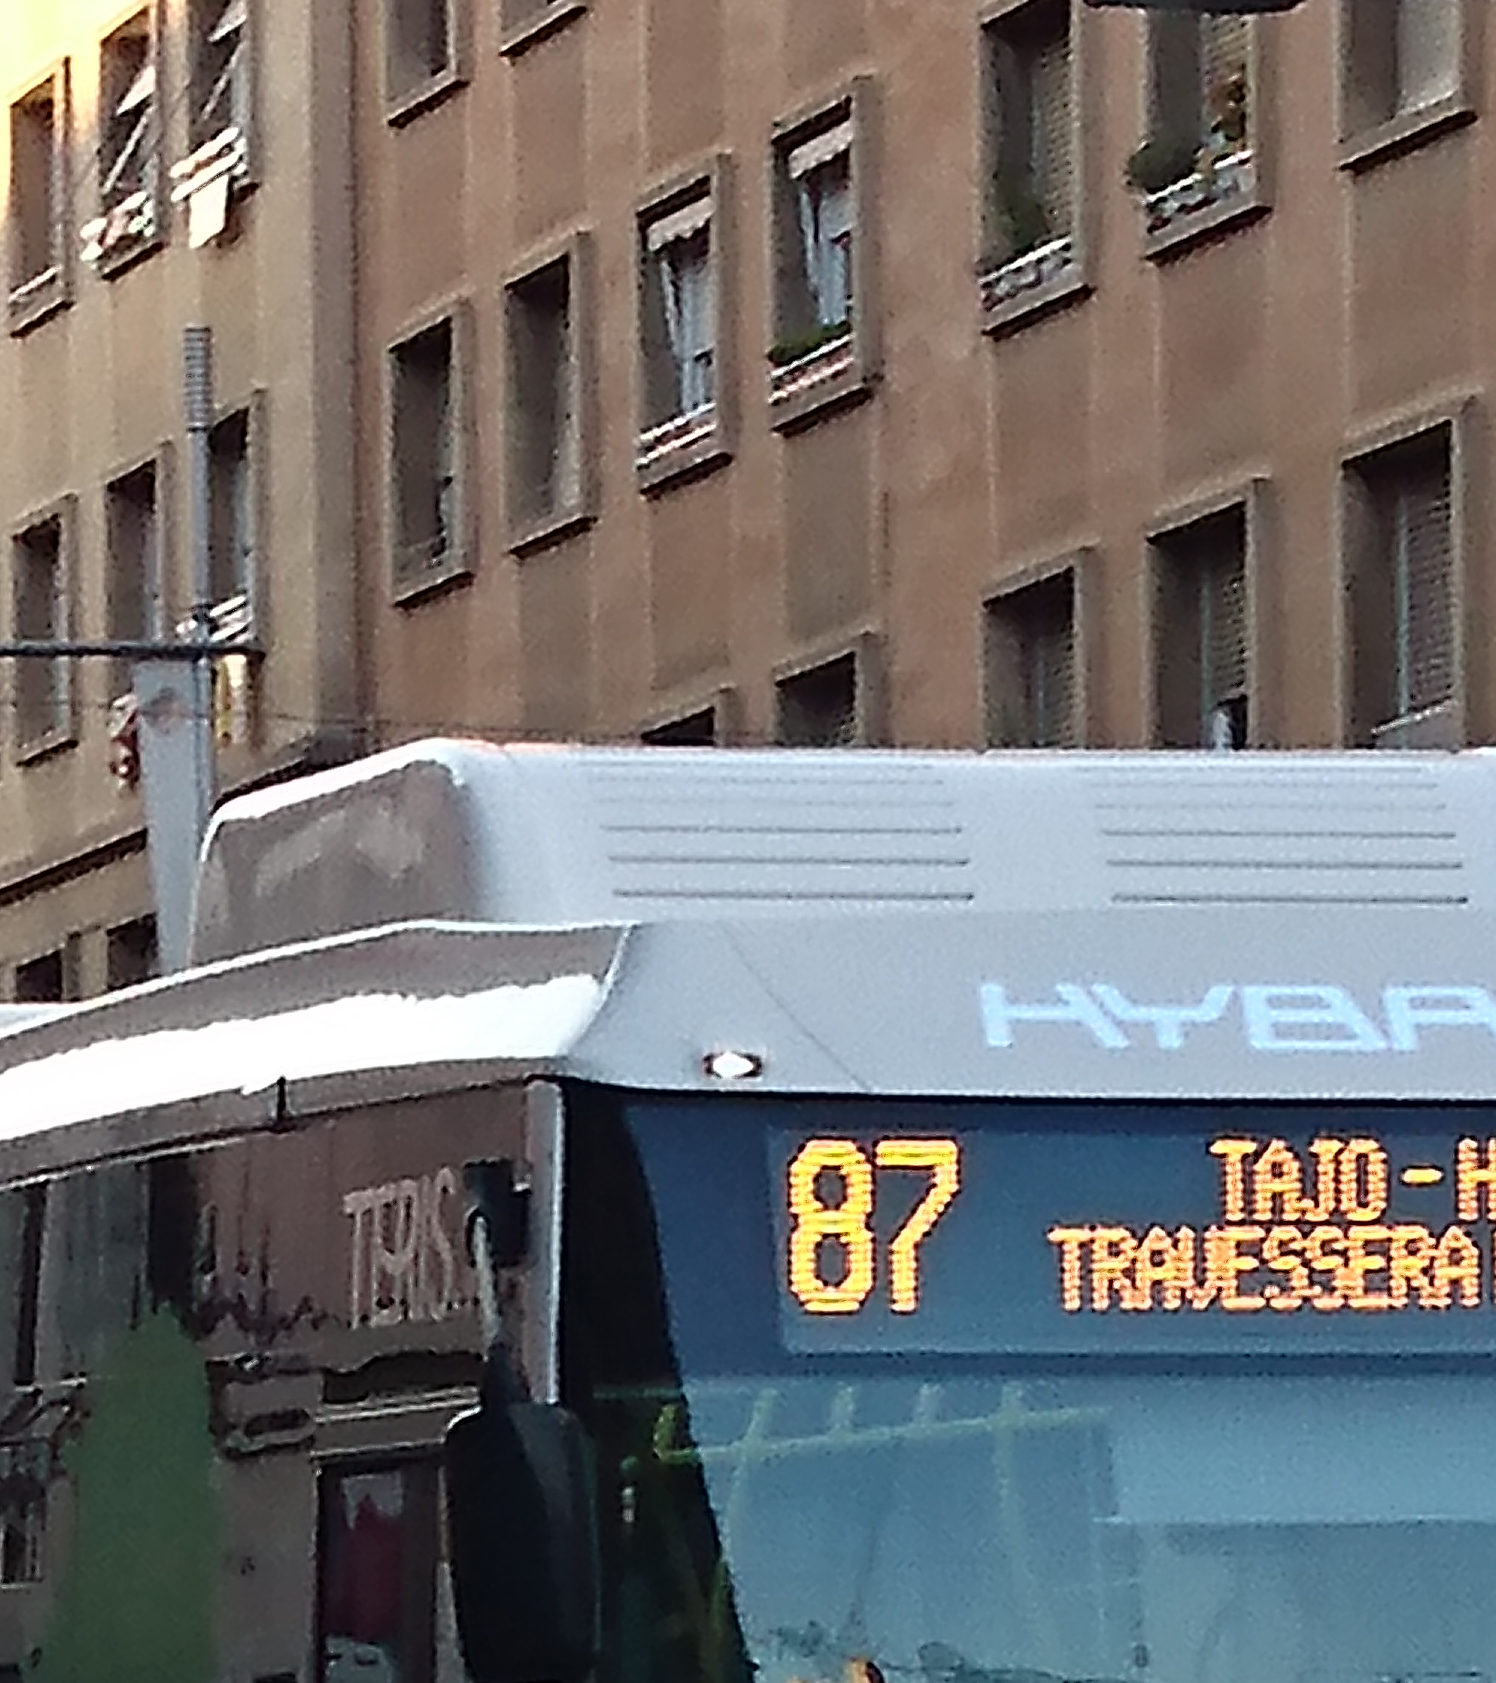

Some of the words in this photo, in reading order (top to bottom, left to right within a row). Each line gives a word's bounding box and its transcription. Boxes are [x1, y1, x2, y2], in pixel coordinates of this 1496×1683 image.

[1210, 1138, 1389, 1222] TAJO
[788, 1138, 960, 1312] 87
[1048, 1225, 1481, 1311] TRAVESSERA
